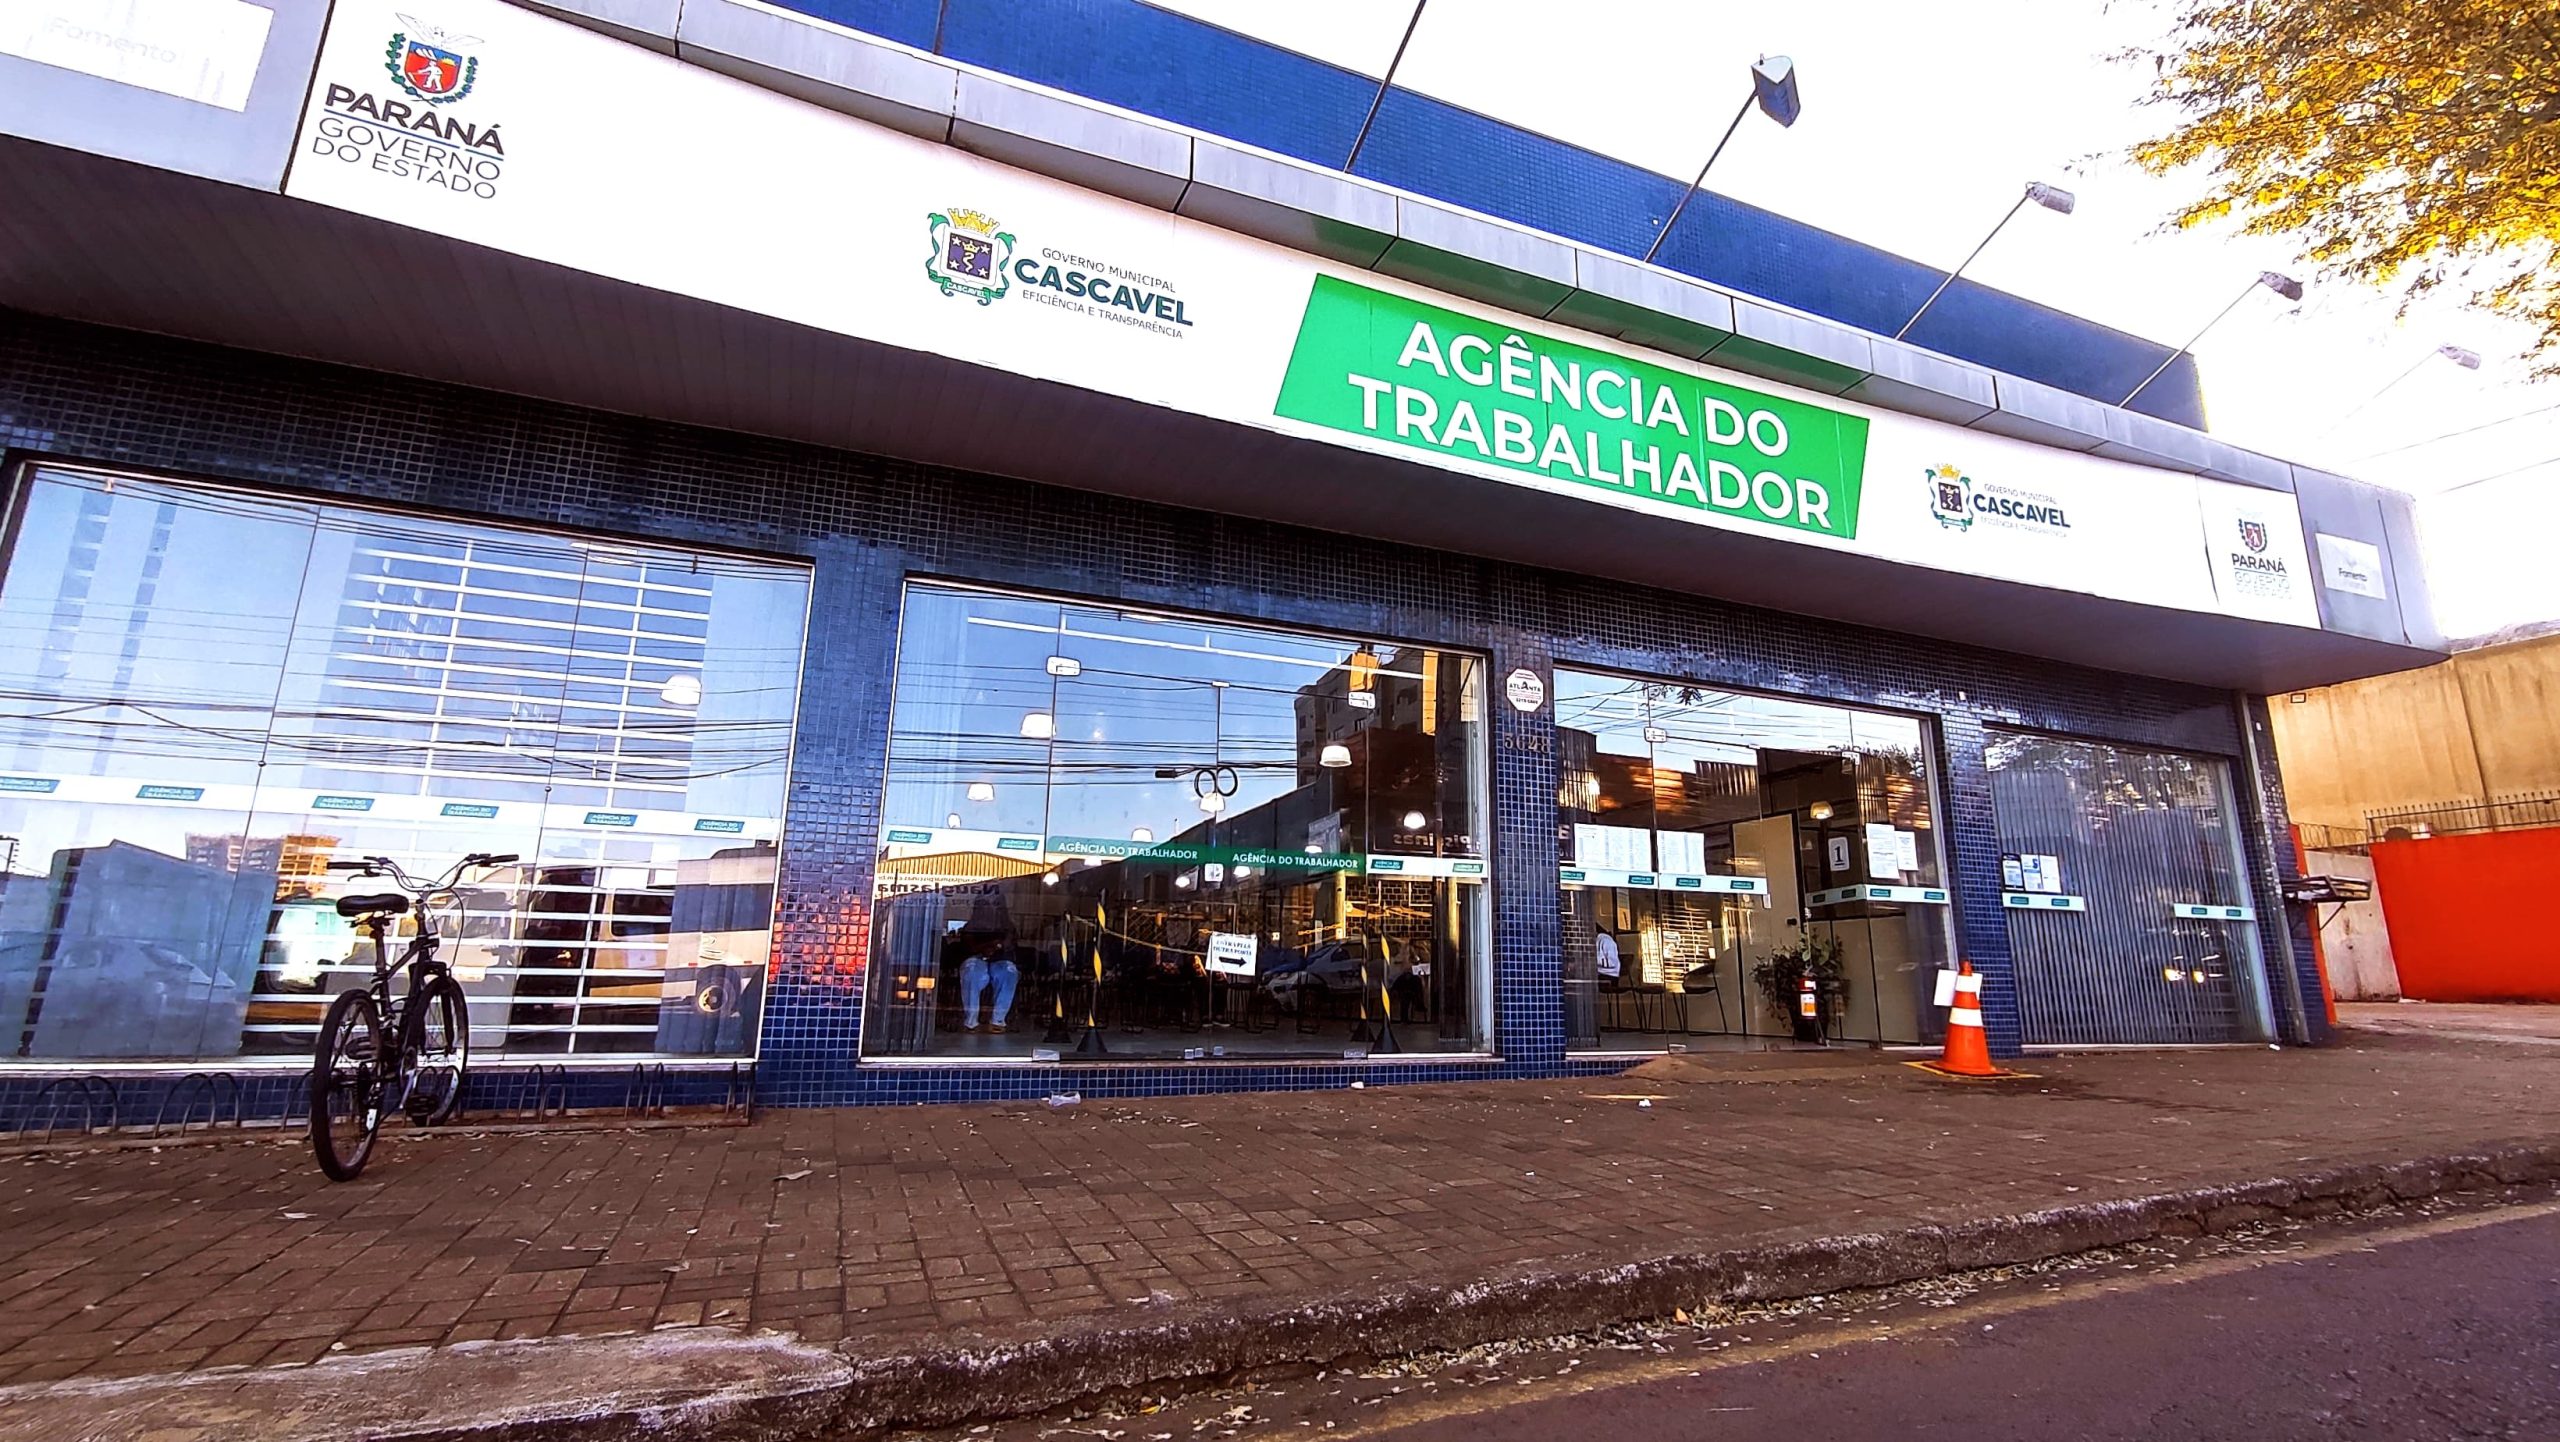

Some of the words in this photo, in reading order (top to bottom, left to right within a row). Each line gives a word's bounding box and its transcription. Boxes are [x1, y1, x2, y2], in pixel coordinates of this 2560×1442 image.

[49, 16, 177, 63] Fomento
[325, 83, 504, 155] PARANÁ
[313, 137, 361, 162] DO
[372, 153, 496, 199] ESTADO
[319, 117, 500, 180] GOVERNO
[1014, 258, 1193, 326] CASCAVEL
[1042, 247, 1105, 273] GOVERNO
[1108, 265, 1176, 293] MUNICIPAL
[1022, 289, 1085, 314] EFICIÊNCIA
[1088, 306, 1095, 316] E
[1098, 308, 1183, 339] TRANSPARÊNCIA
[1396, 320, 1690, 437] AGÊNCIA
[1703, 396, 1789, 458] DO
[1347, 373, 1832, 530] TRABALHADOR
[1973, 494, 2071, 528] CASCAVEL
[1984, 483, 2019, 497] GOVERNO
[2231, 553, 2287, 574] PARANÁ
[1508, 681, 1541, 692] ATLANTA
[1058, 841, 1107, 854] AGÊNCIA
[1109, 845, 1126, 855] DO
[1128, 848, 1198, 860] TRABALHADOR
[1232, 852, 1276, 864] AGÊNCIA
[1278, 856, 1293, 865] DO
[1295, 857, 1358, 868] TRABALHADOR
[1834, 845, 1843, 862] 1
